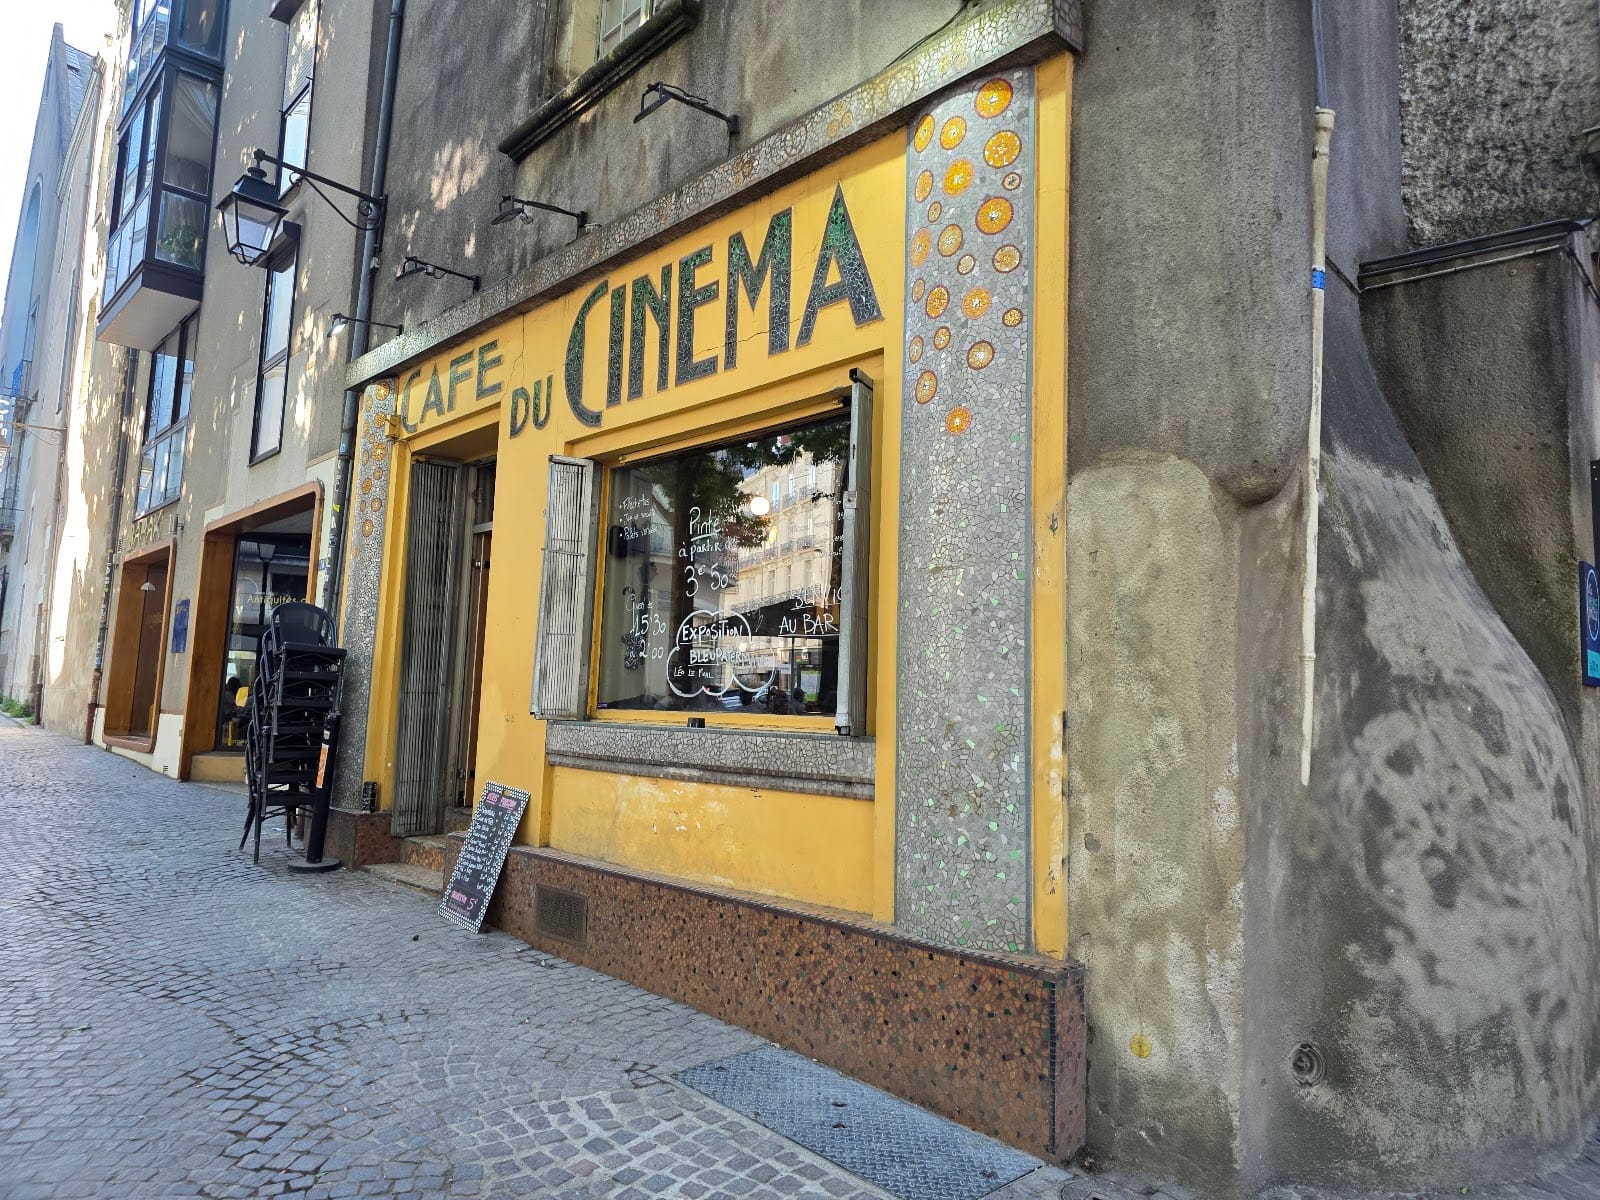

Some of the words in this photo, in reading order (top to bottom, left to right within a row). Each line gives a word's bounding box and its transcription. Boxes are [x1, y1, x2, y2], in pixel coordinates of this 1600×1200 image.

[401, 339, 504, 434] CAFE
[509, 374, 553, 440] DU
[564, 181, 884, 428] CINEMA
[689, 506, 721, 535] Pinte
[779, 615, 797, 634] AU
[802, 613, 839, 634] BAR
